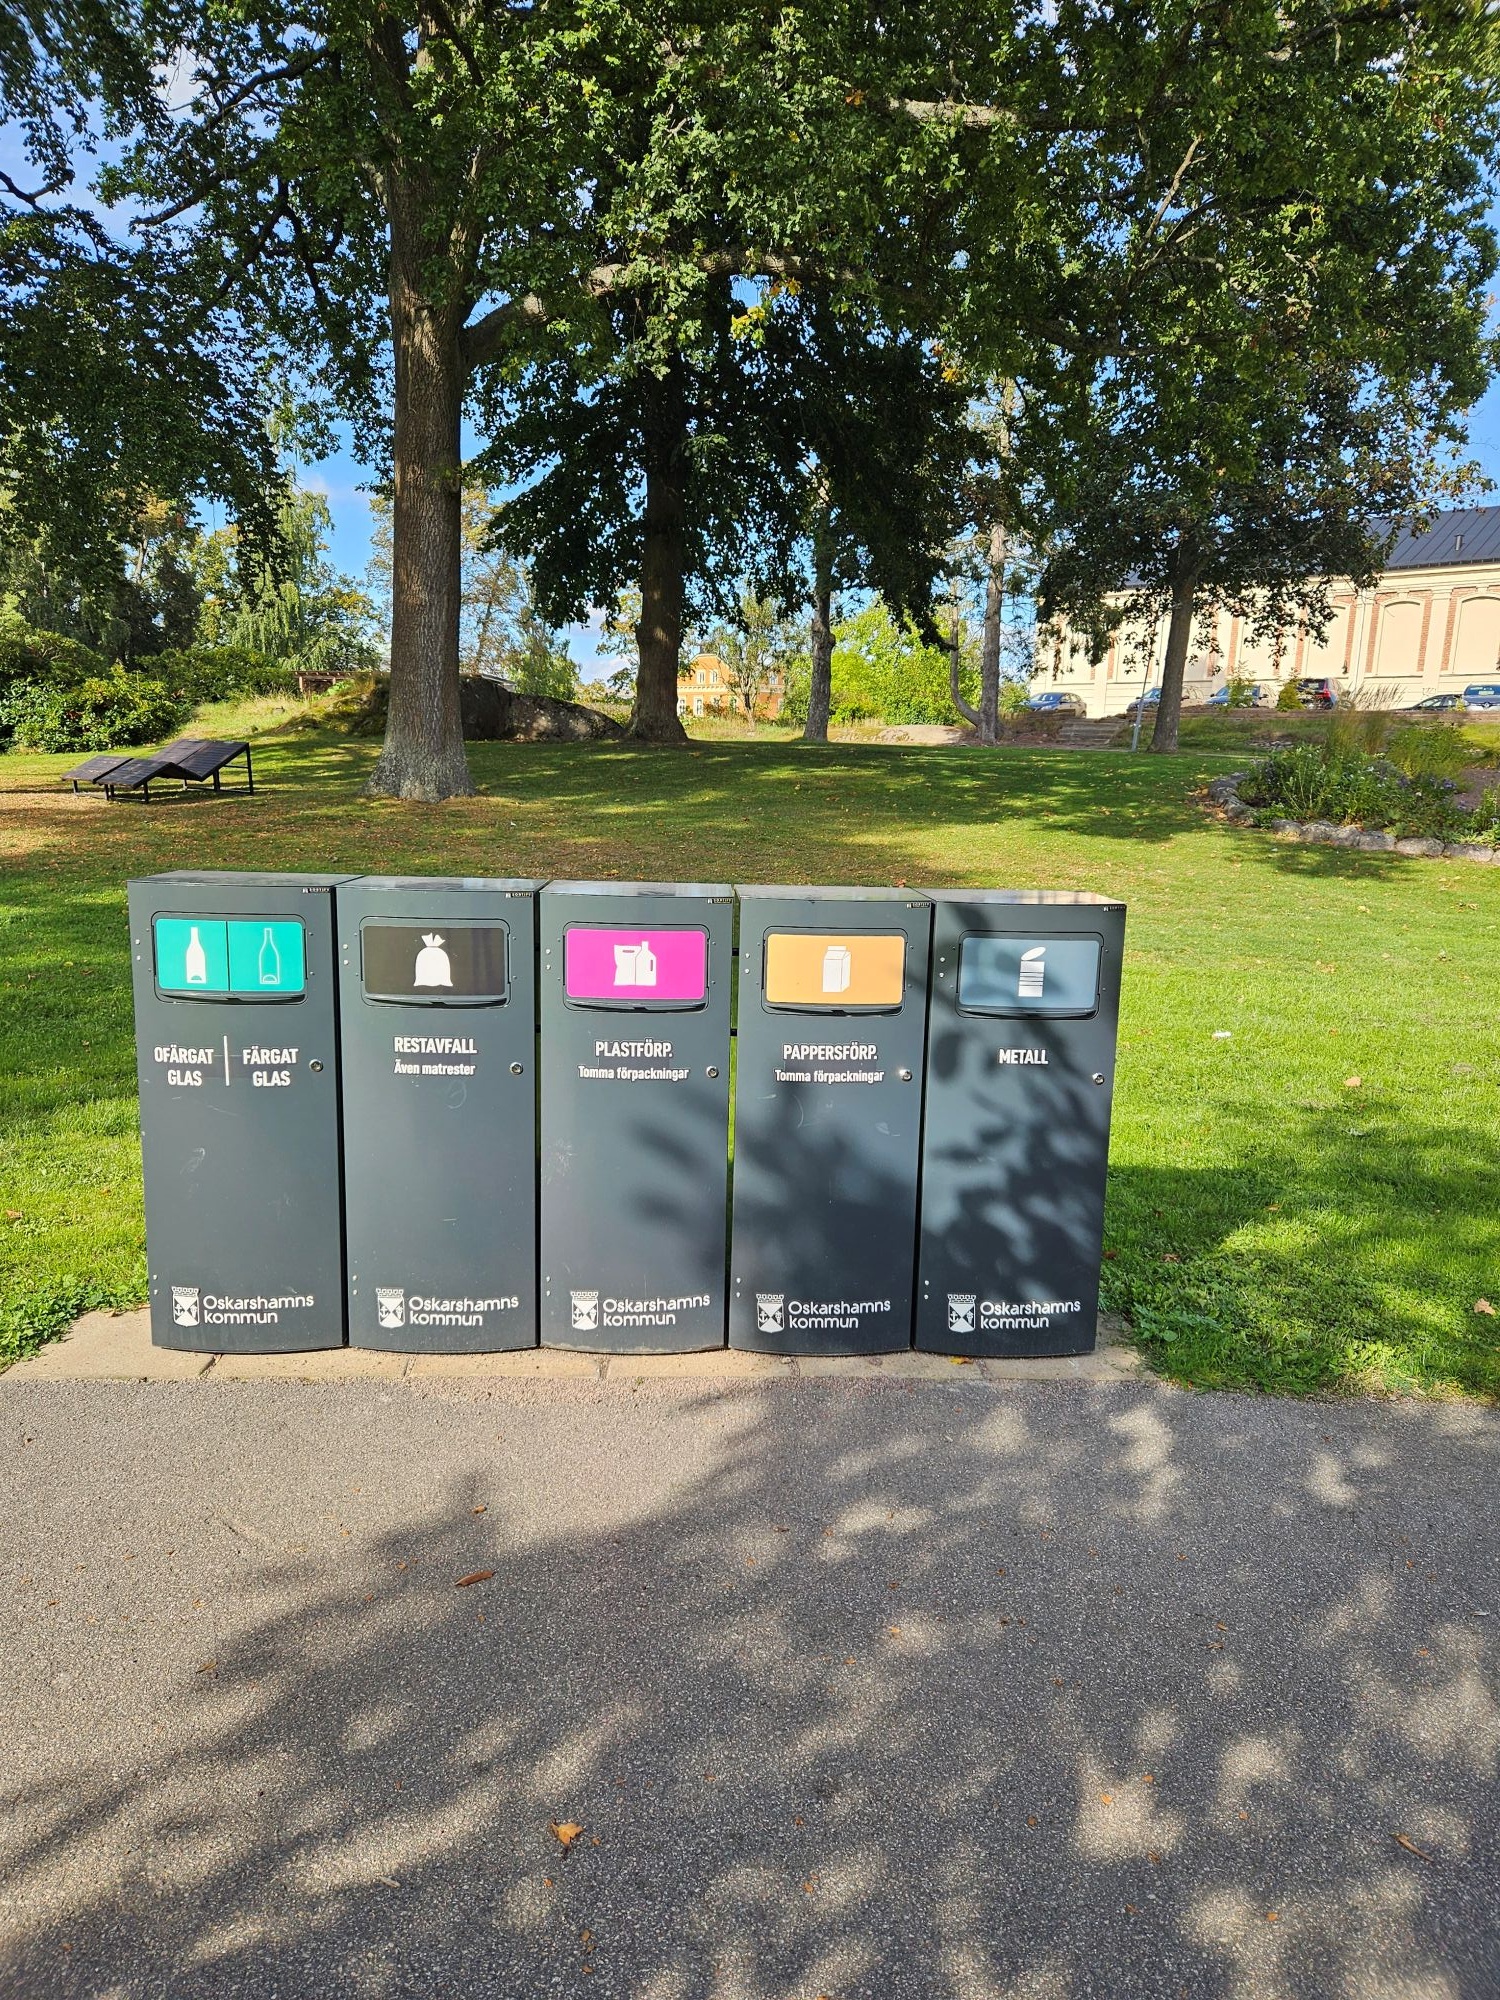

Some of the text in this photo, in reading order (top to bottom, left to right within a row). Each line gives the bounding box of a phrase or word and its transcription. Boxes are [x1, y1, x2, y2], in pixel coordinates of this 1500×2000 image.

[394, 1035, 477, 1054] RESTAVFALL
[595, 1039, 672, 1058] PLASTFÖRP.
[783, 1042, 877, 1060] PAPPERSFÖRP.
[154, 1045, 214, 1064] OFÄRGAT
[242, 1046, 298, 1064] FÄRGAT
[998, 1049, 1048, 1065] METALL
[394, 1059, 476, 1076] Även matrester
[578, 1066, 690, 1082] Tomma förpackningar
[168, 1069, 202, 1087] GLAS
[253, 1070, 290, 1087] GLAS
[775, 1069, 885, 1085] Tomma förpackningar
[203, 1295, 314, 1311] Oskarshamns
[409, 1296, 519, 1312] Oskarshamns
[603, 1295, 711, 1312] Oskarshamns
[788, 1300, 891, 1314] Oskarshamns
[980, 1300, 1080, 1315] Oskarshamns
[204, 1309, 278, 1325] kommun
[410, 1310, 483, 1326] kommun
[603, 1312, 677, 1327] kommun
[790, 1314, 859, 1329] kommun
[981, 1315, 1049, 1329] kommun
